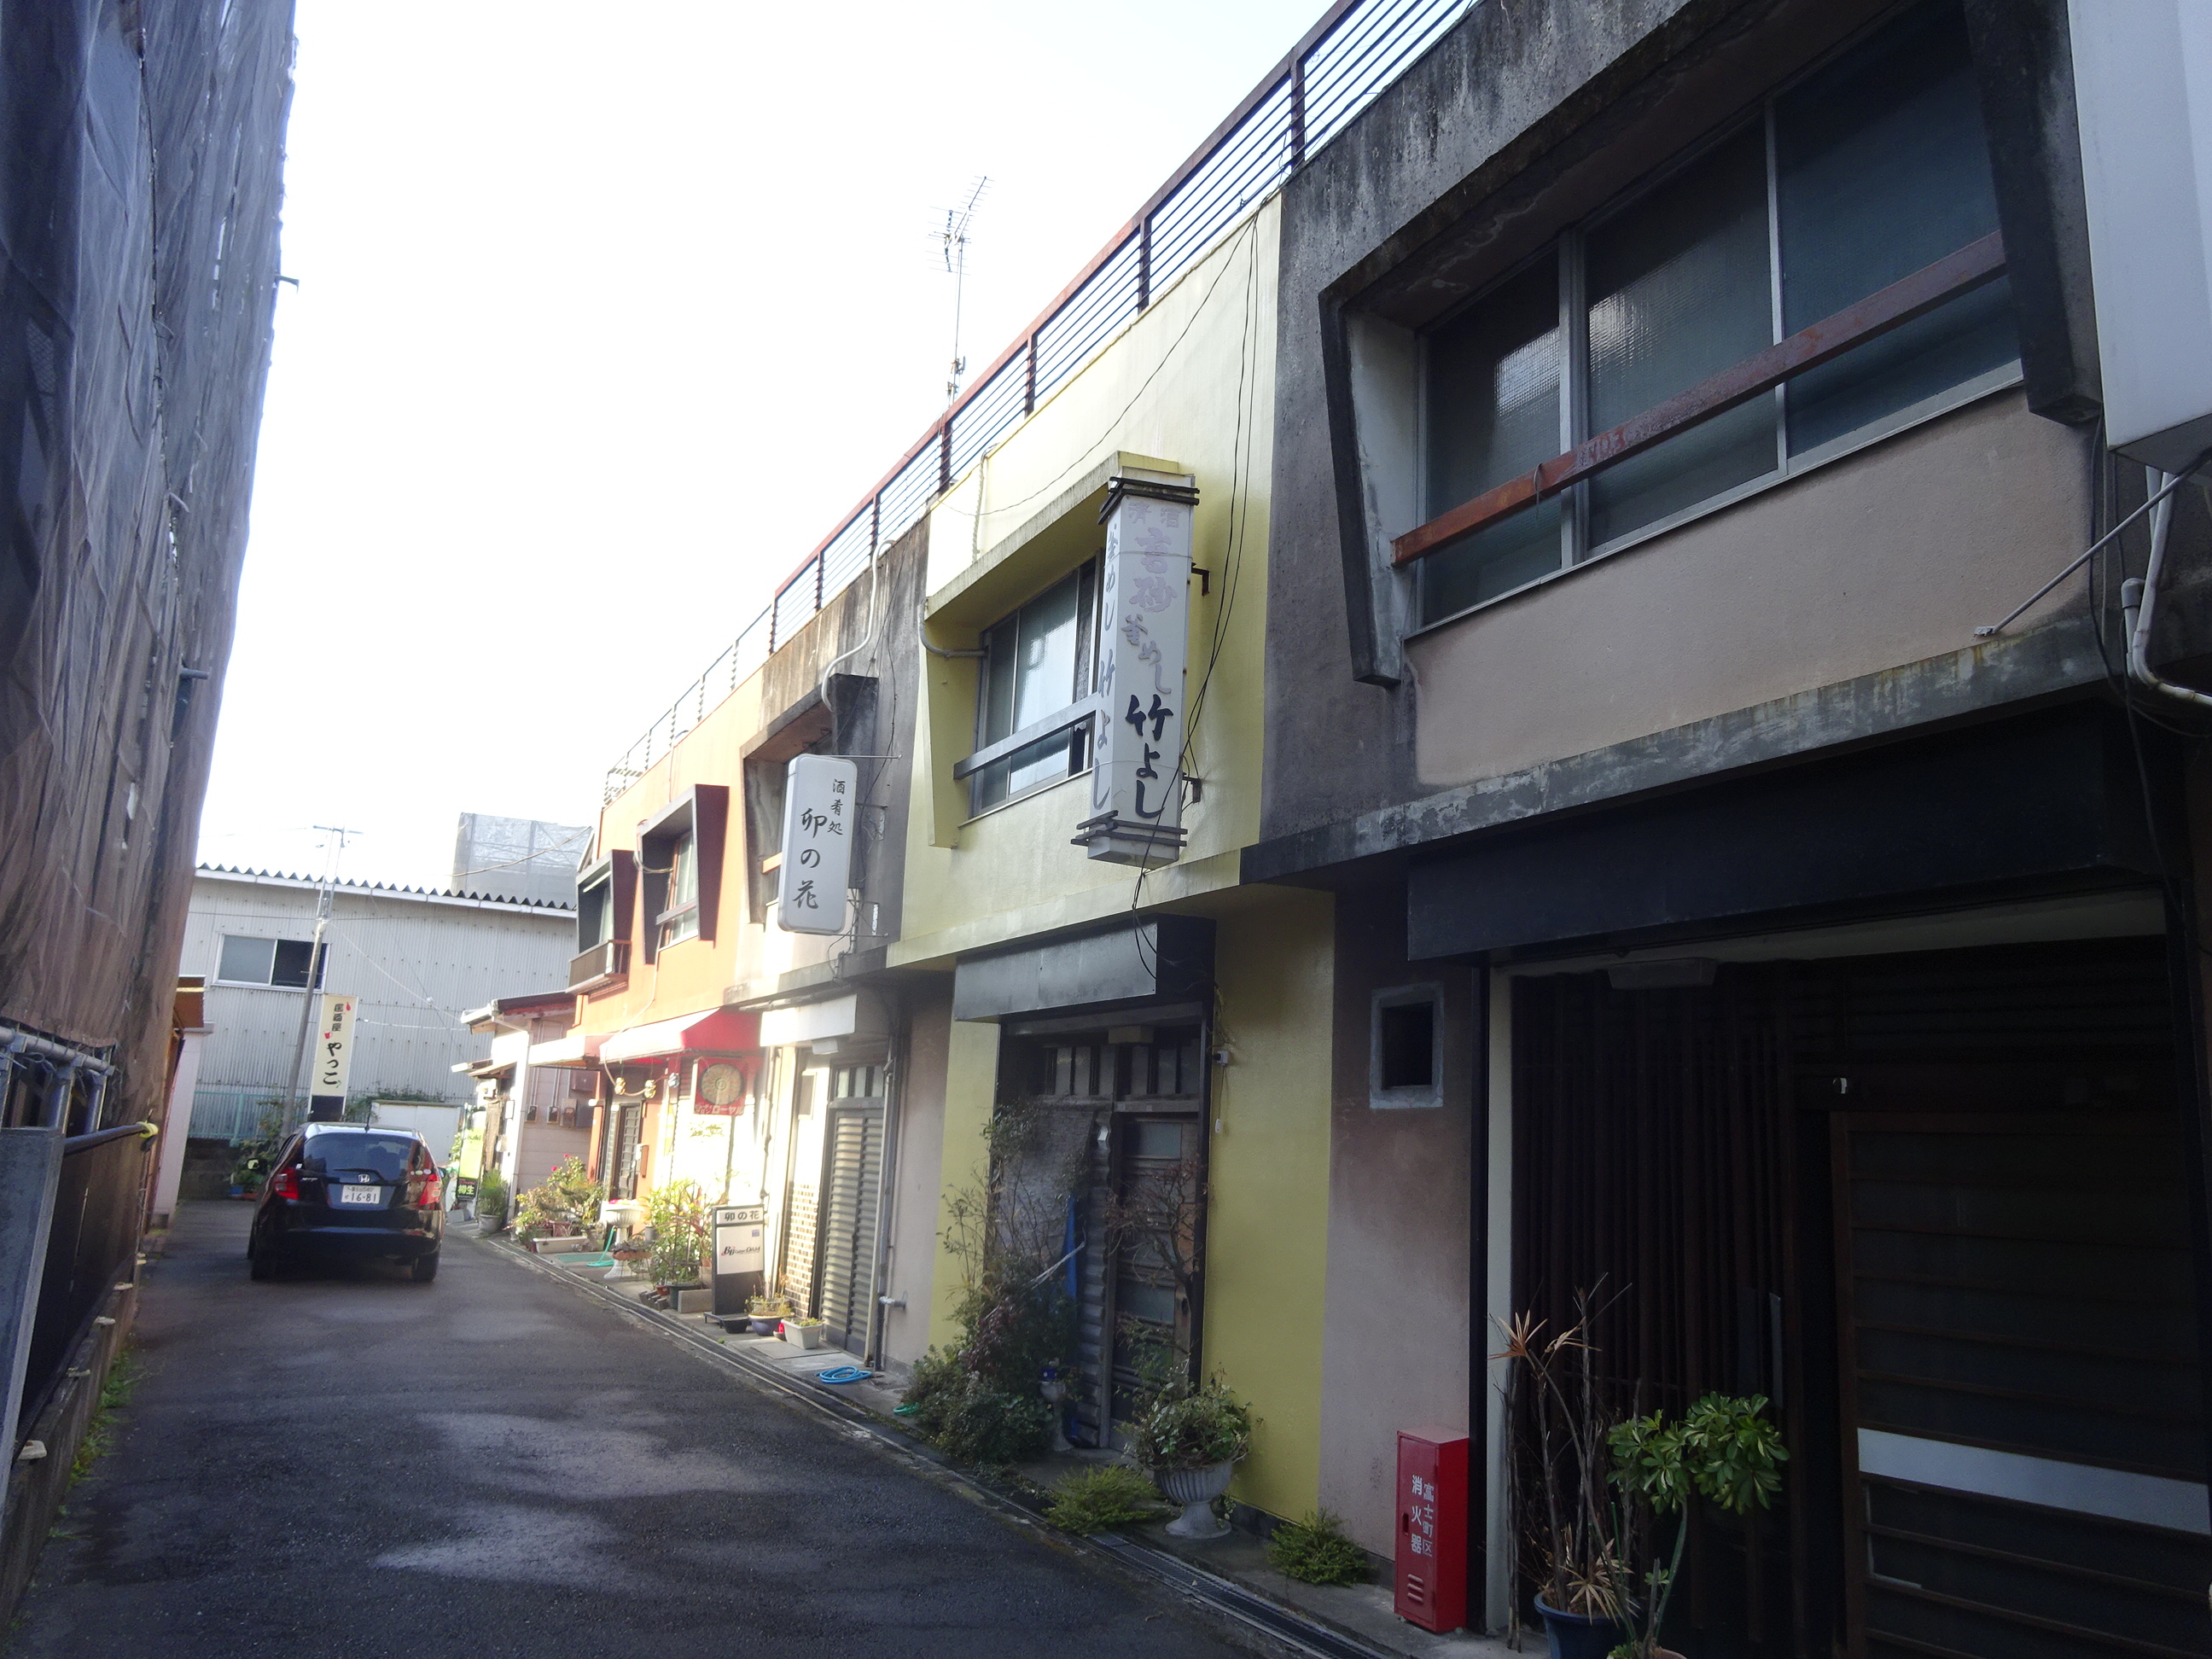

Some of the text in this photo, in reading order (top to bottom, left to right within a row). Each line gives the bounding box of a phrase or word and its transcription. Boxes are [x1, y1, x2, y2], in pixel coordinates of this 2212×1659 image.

[1125, 694, 1174, 818] 竹よし
[827, 778, 847, 835] 酒肴処
[792, 807, 828, 910] 卯の花
[323, 1042, 342, 1085] やっこ
[351, 1192, 376, 1202] 16-81
[725, 1210, 760, 1221] 卯の花
[1411, 1474, 1423, 1555] 消火器
